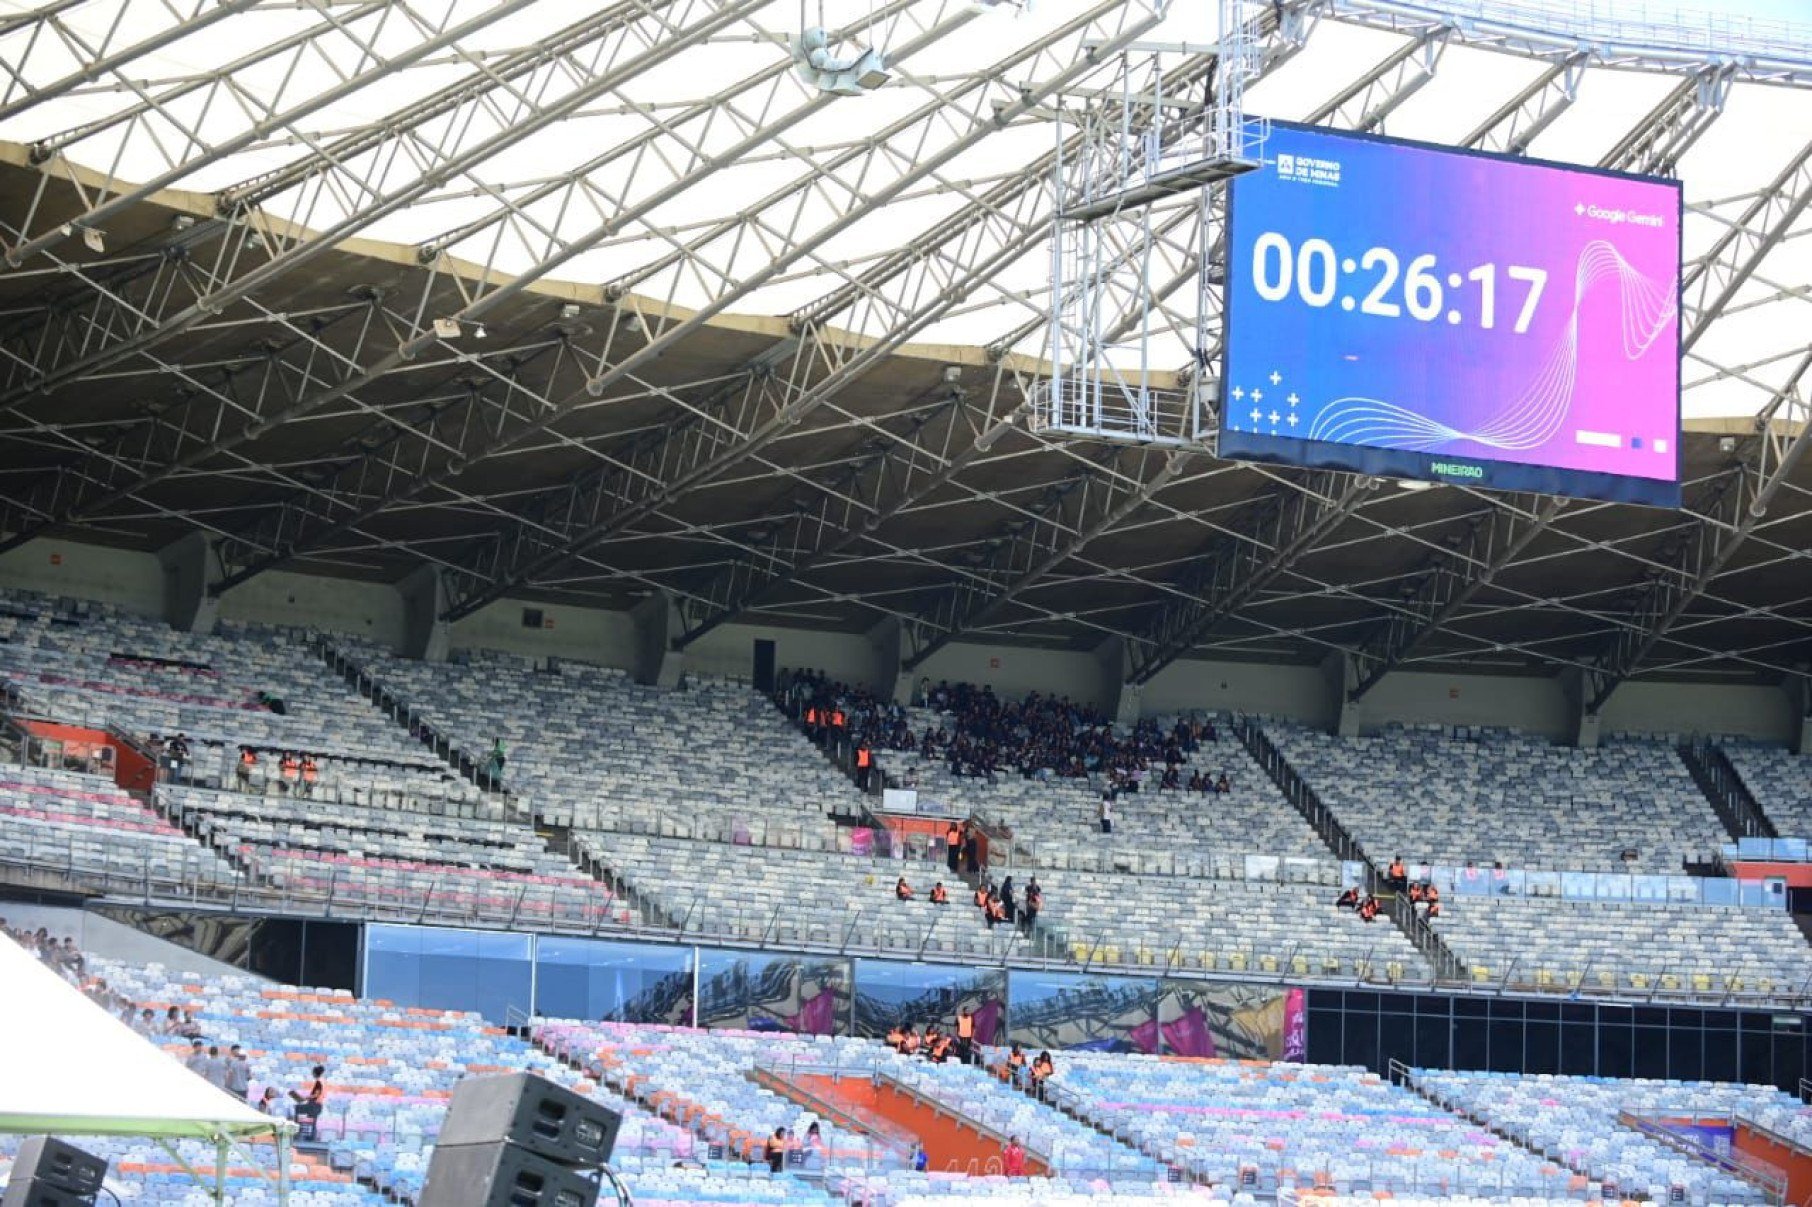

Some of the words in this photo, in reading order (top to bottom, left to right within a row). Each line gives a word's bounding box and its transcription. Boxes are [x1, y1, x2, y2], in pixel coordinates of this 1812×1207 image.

[1296, 157, 1340, 170] GOVERNO
[1587, 205, 1626, 224] Google
[1628, 210, 1663, 227] Gemini
[1252, 232, 1548, 334] 00:26:17
